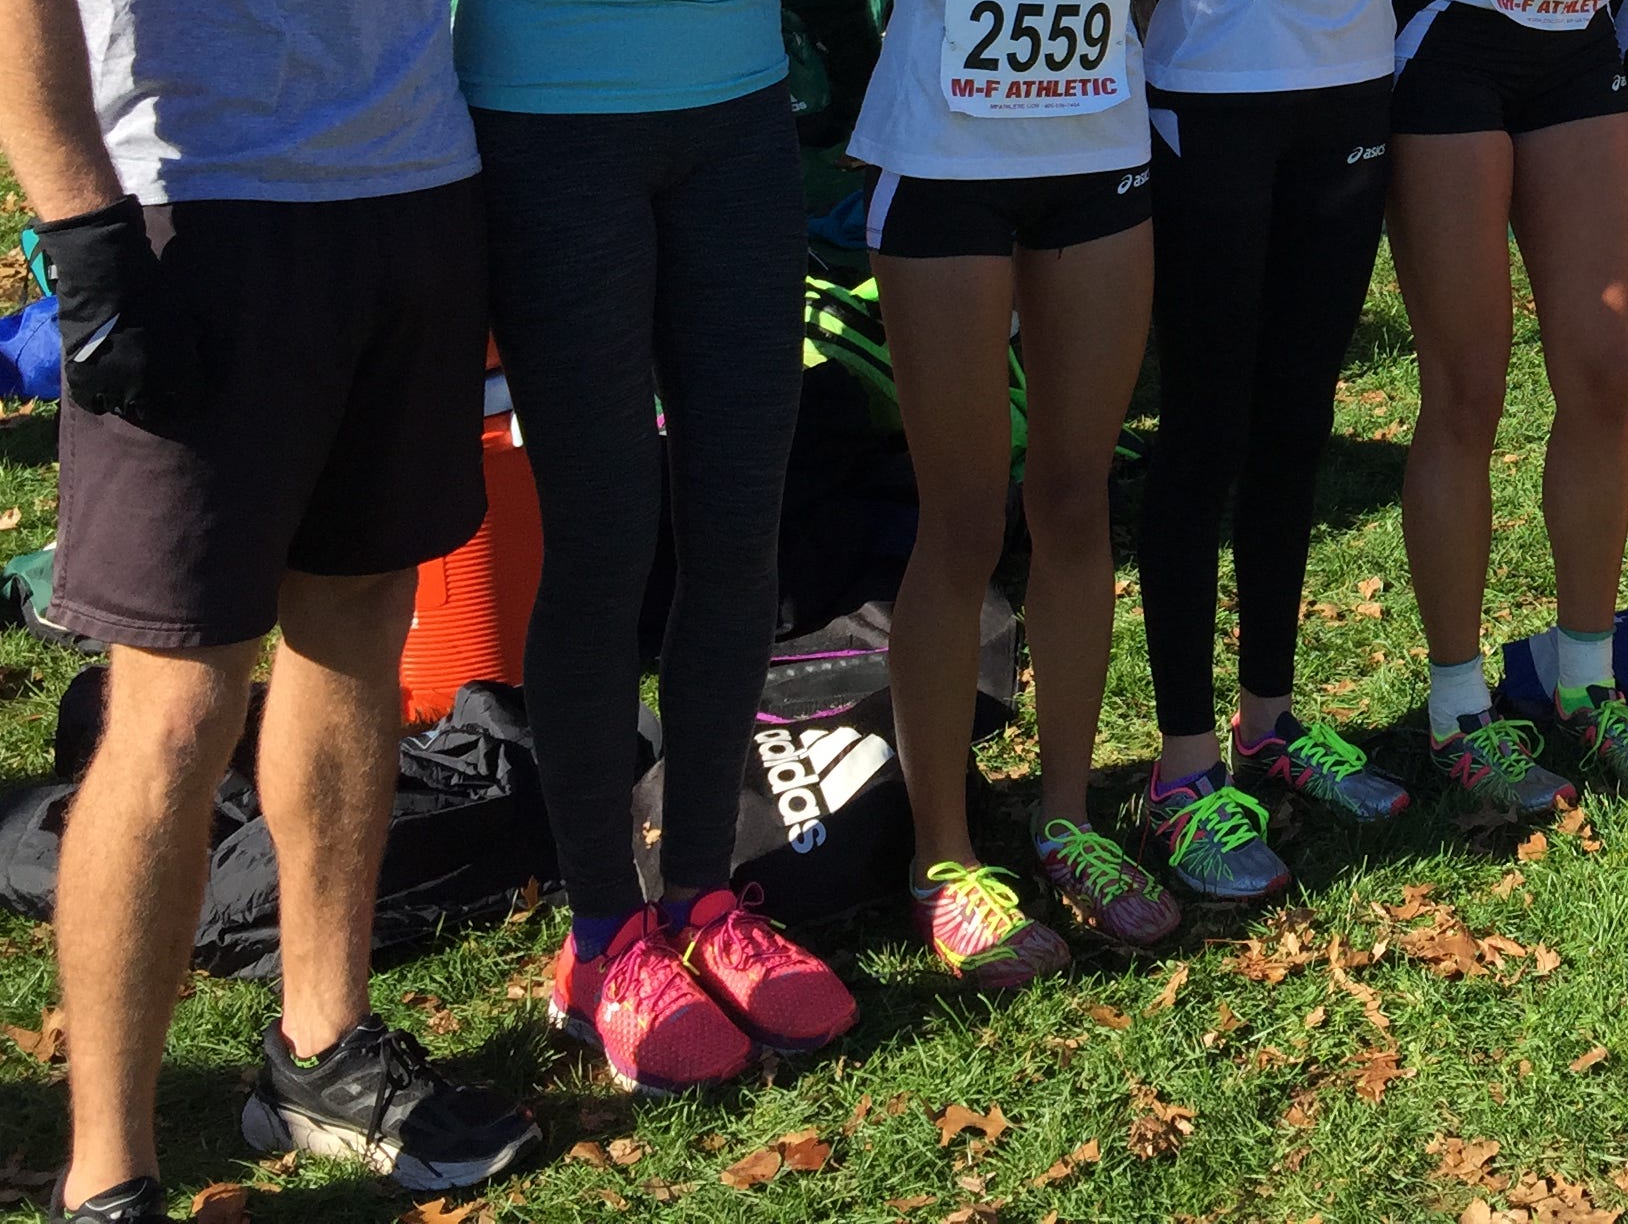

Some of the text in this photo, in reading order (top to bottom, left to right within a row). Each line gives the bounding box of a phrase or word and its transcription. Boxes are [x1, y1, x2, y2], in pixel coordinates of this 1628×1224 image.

[963, 0, 1112, 73] 2559
[951, 77, 1118, 99] M-F ATHLETIC
[753, 727, 827, 854] adidas
